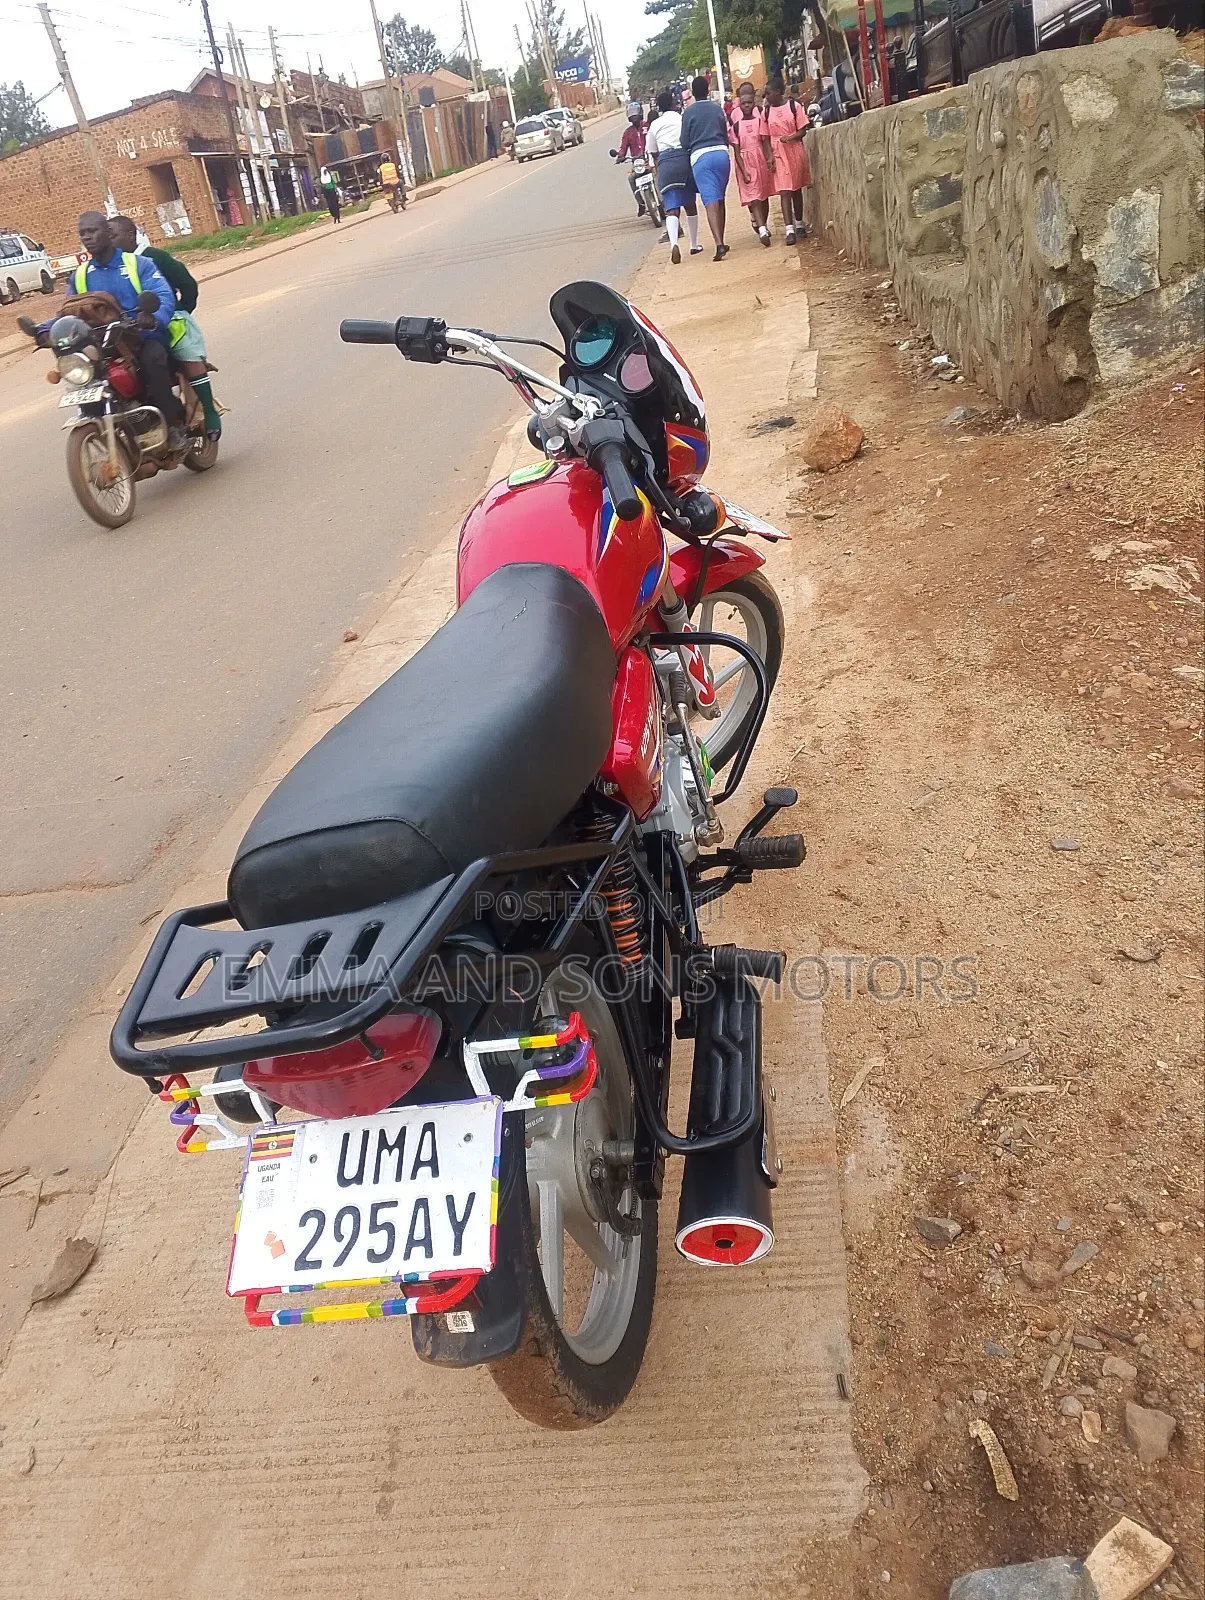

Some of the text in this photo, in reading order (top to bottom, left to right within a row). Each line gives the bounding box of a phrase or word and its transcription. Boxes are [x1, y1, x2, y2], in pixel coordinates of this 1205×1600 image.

[555, 67, 578, 80] Lyca
[116, 127, 180, 158] NOT 4 SALE
[257, 1162, 281, 1173] UGANDA
[336, 1121, 440, 1188] UMA
[293, 1191, 477, 1272] 295AY
